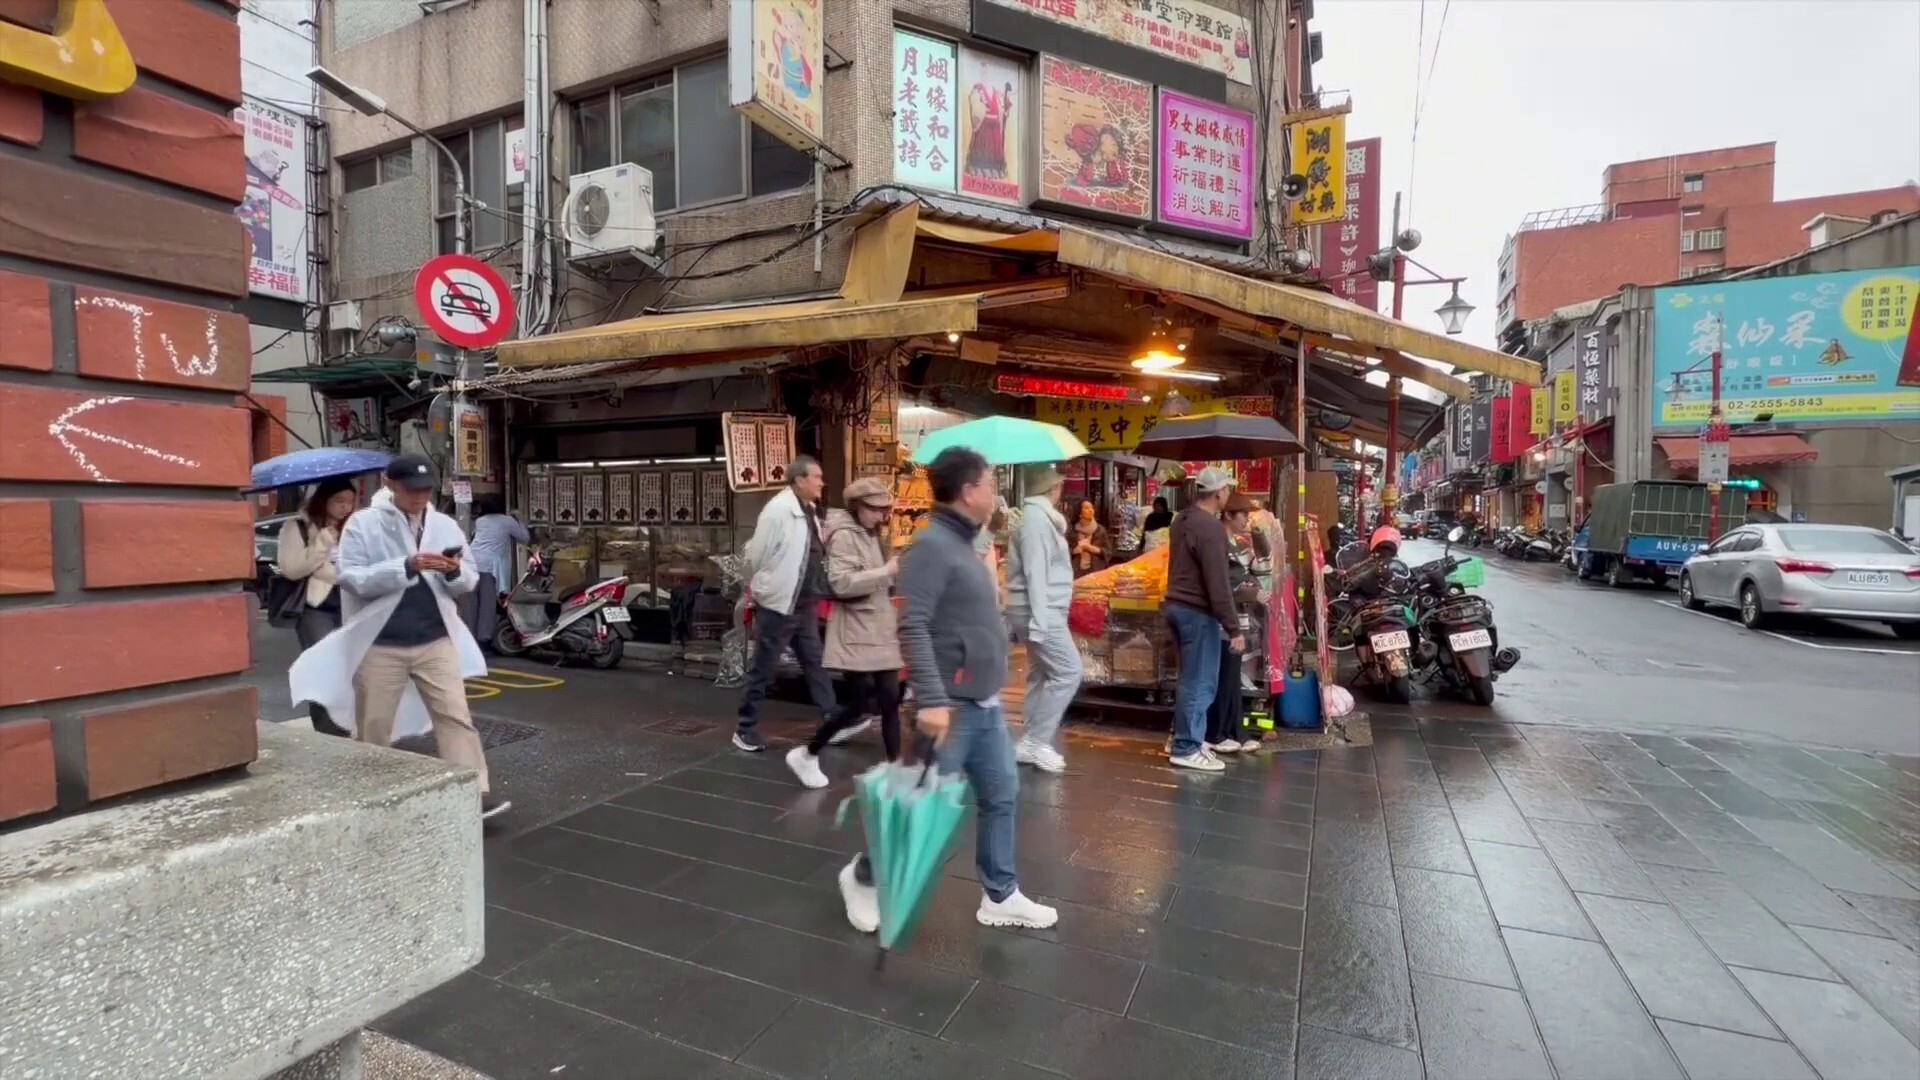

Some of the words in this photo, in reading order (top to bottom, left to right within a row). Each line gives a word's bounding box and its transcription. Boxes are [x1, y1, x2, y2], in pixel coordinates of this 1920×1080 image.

[1124, 0, 1233, 42] 福堂命理館
[897, 46, 922, 169] 月老籤詩
[925, 53, 950, 172] 姻緣和合
[1167, 109, 1246, 149] 男女姻緣感情
[1172, 139, 1242, 173] 事業財運
[1173, 165, 1242, 198] 祈福禮斗
[1173, 191, 1242, 222] 消災解厄
[249, 266, 289, 293] 幸福
[1728, 397, 1823, 410] 02-2555-5843
